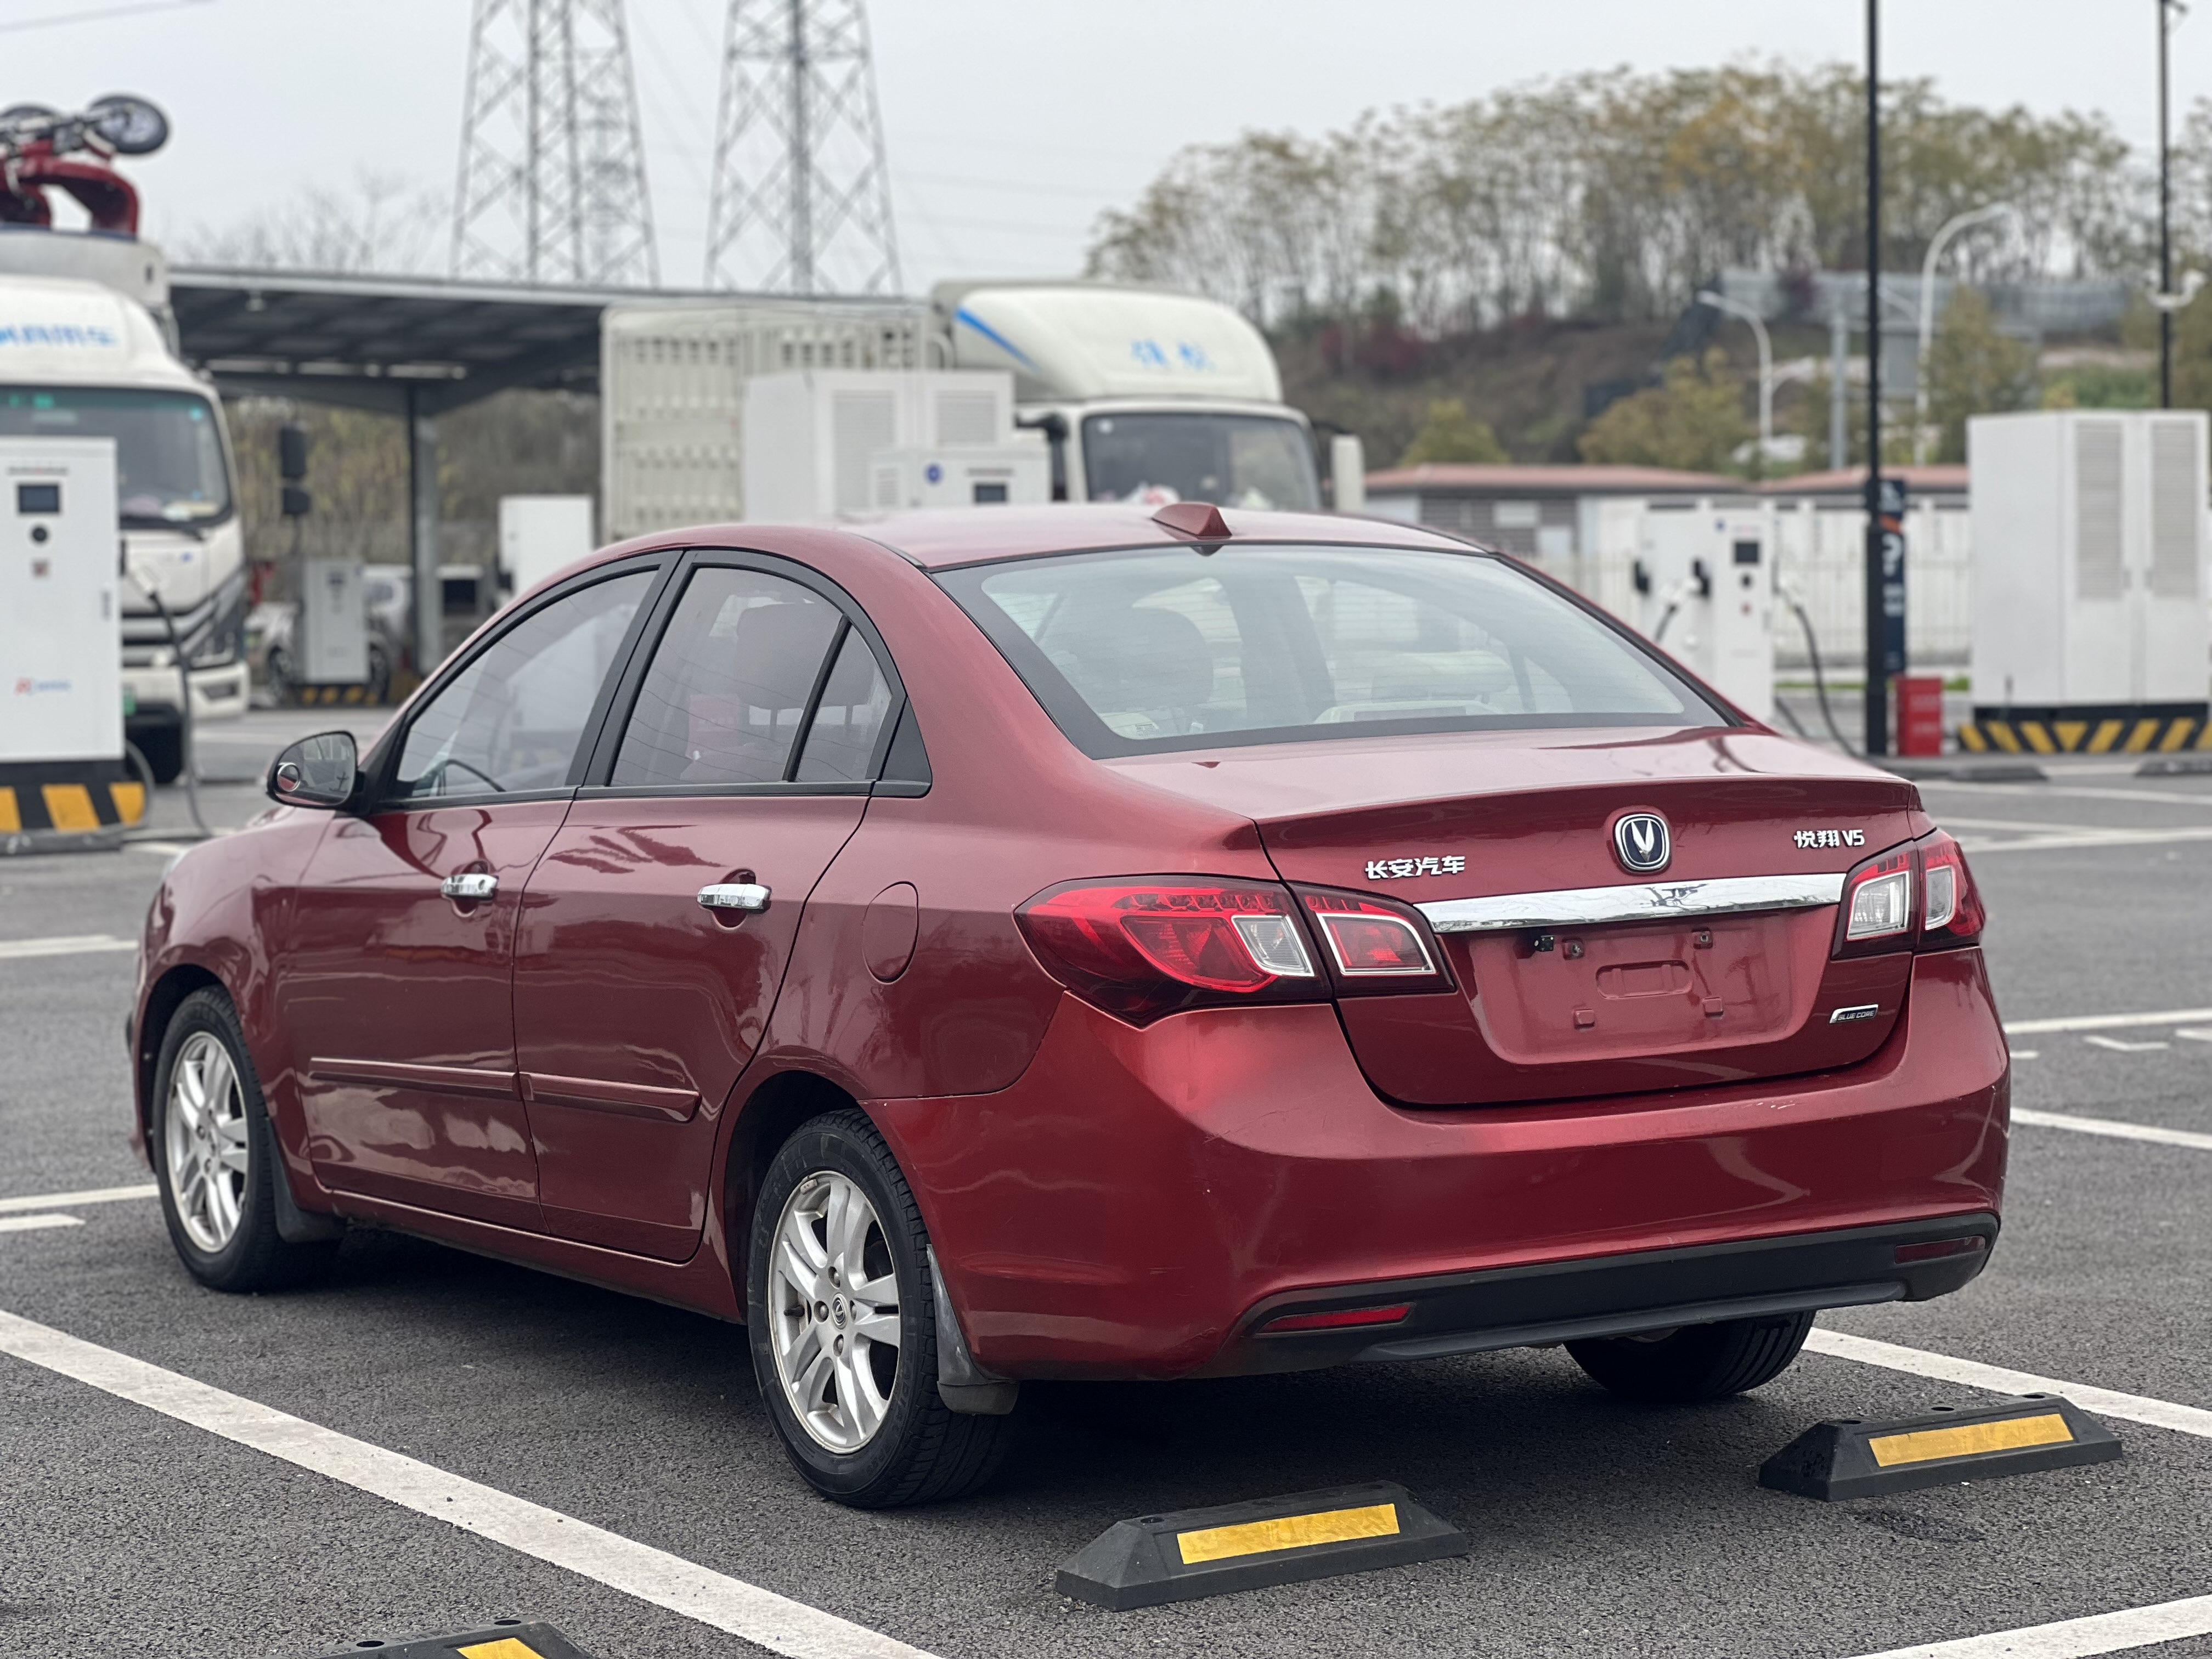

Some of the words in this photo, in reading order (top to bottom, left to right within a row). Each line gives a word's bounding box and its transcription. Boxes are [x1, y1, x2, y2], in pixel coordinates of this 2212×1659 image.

[1793, 830, 1839, 848] 悦翔
[1842, 830, 1865, 846] V5
[1365, 855, 1465, 879] 长安汽车
